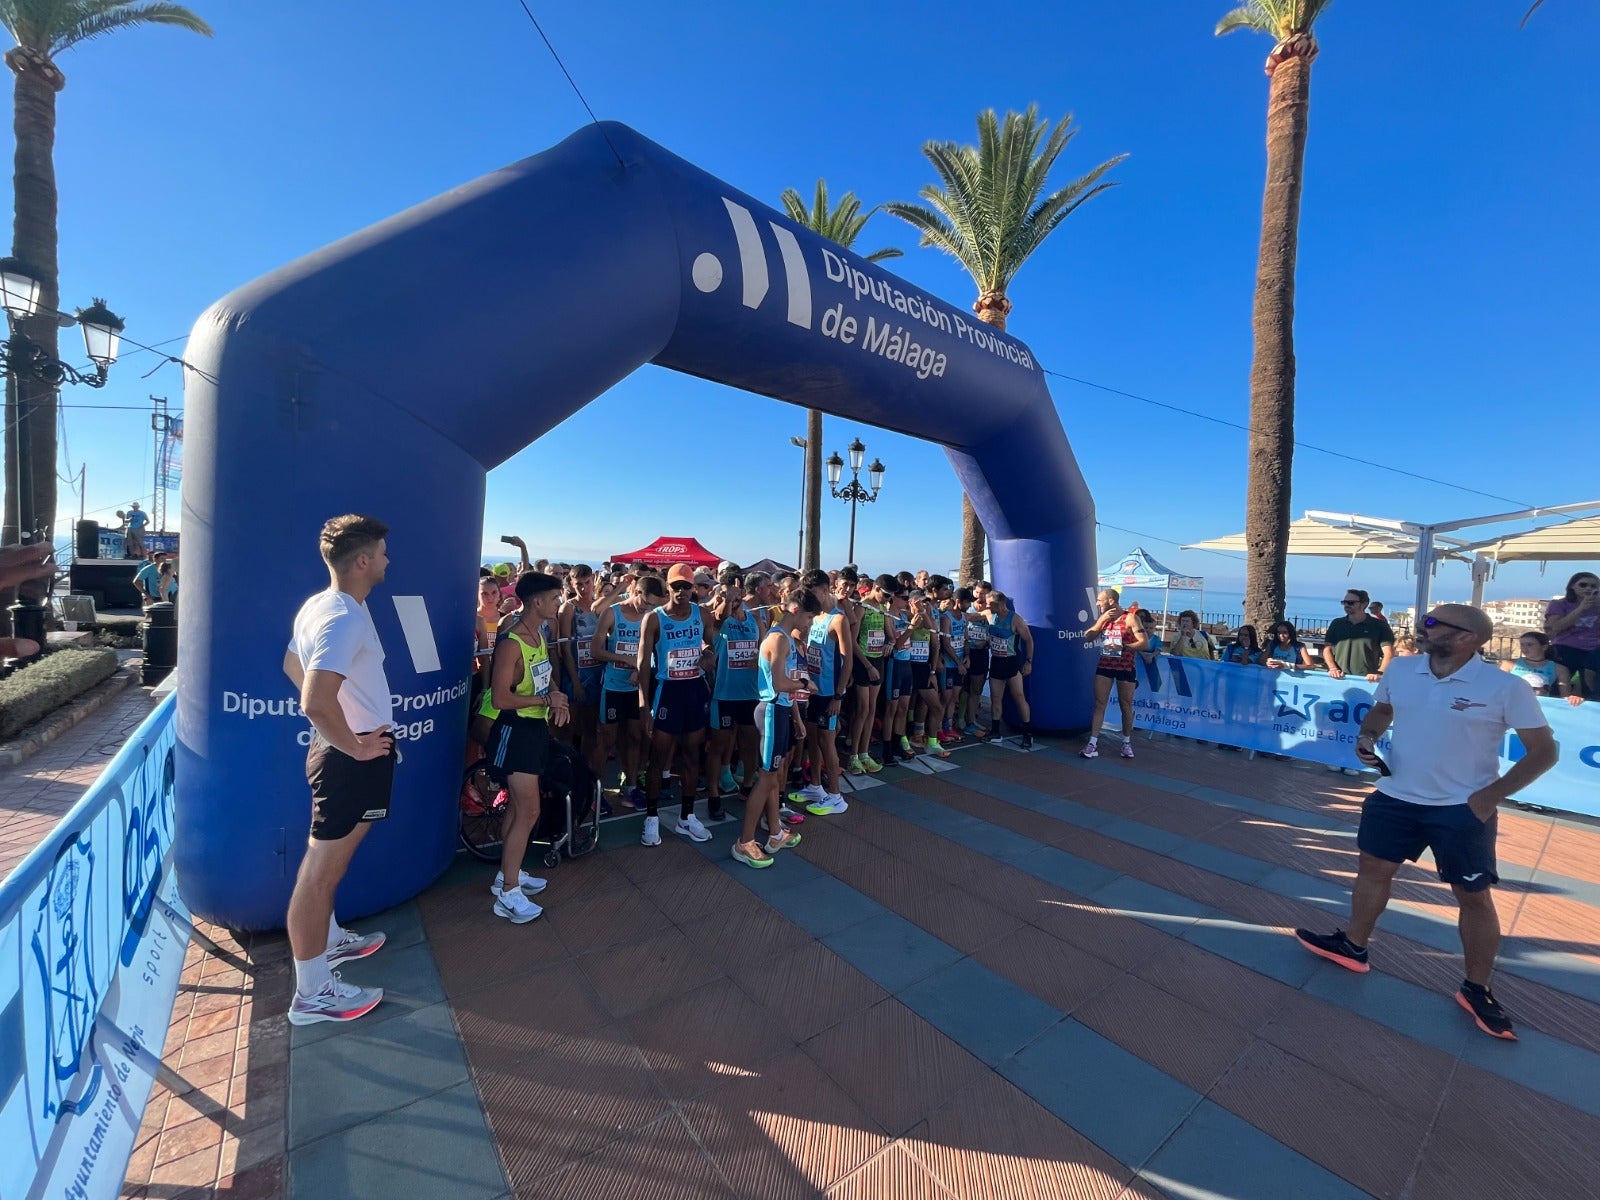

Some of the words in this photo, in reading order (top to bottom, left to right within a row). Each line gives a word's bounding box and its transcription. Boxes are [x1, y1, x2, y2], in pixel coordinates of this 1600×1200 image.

[822, 248, 953, 334] Diputación
[952, 313, 1034, 371] Provincial
[821, 303, 858, 344] de
[862, 315, 948, 380] Málaga
[666, 625, 700, 640] nerja
[1058, 630, 1086, 641] Diput
[1144, 713, 1187, 729] Málaga
[1164, 702, 1221, 720] Provincial
[296, 726, 316, 746] d
[394, 718, 434, 741] aga
[1273, 722, 1296, 734] más
[1301, 727, 1323, 738] que
[143, 929, 167, 986] sport
[121, 1023, 146, 1063] Nerja
[114, 1060, 131, 1083] de
[63, 1083, 123, 1200] Ayuntamiento
